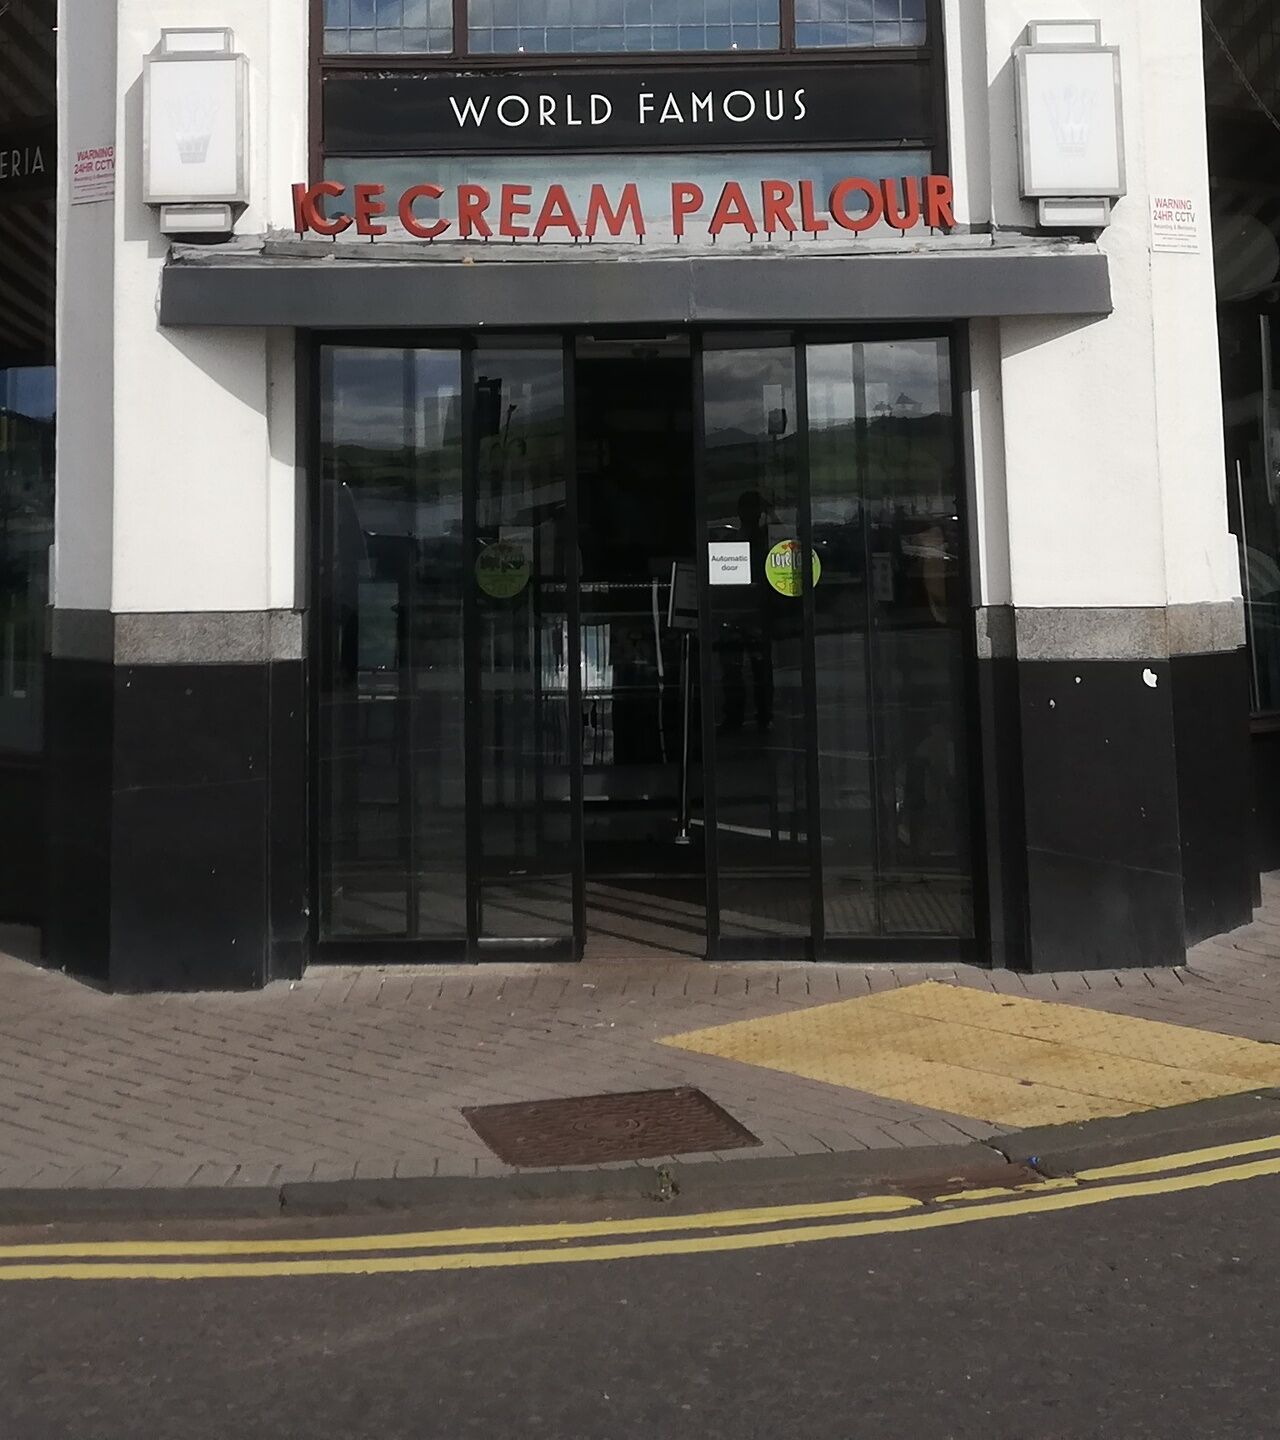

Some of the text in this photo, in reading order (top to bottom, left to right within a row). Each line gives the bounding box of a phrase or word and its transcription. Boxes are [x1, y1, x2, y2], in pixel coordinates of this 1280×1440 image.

[448, 88, 808, 128] WORLD FAMOUS
[77, 146, 114, 161] WARNING
[74, 161, 94, 174] 24HR
[292, 174, 958, 238] ICE CREAM PARLOUR
[1154, 198, 1192, 210] WARNING
[1153, 210, 1195, 222] 24HR CCTV
